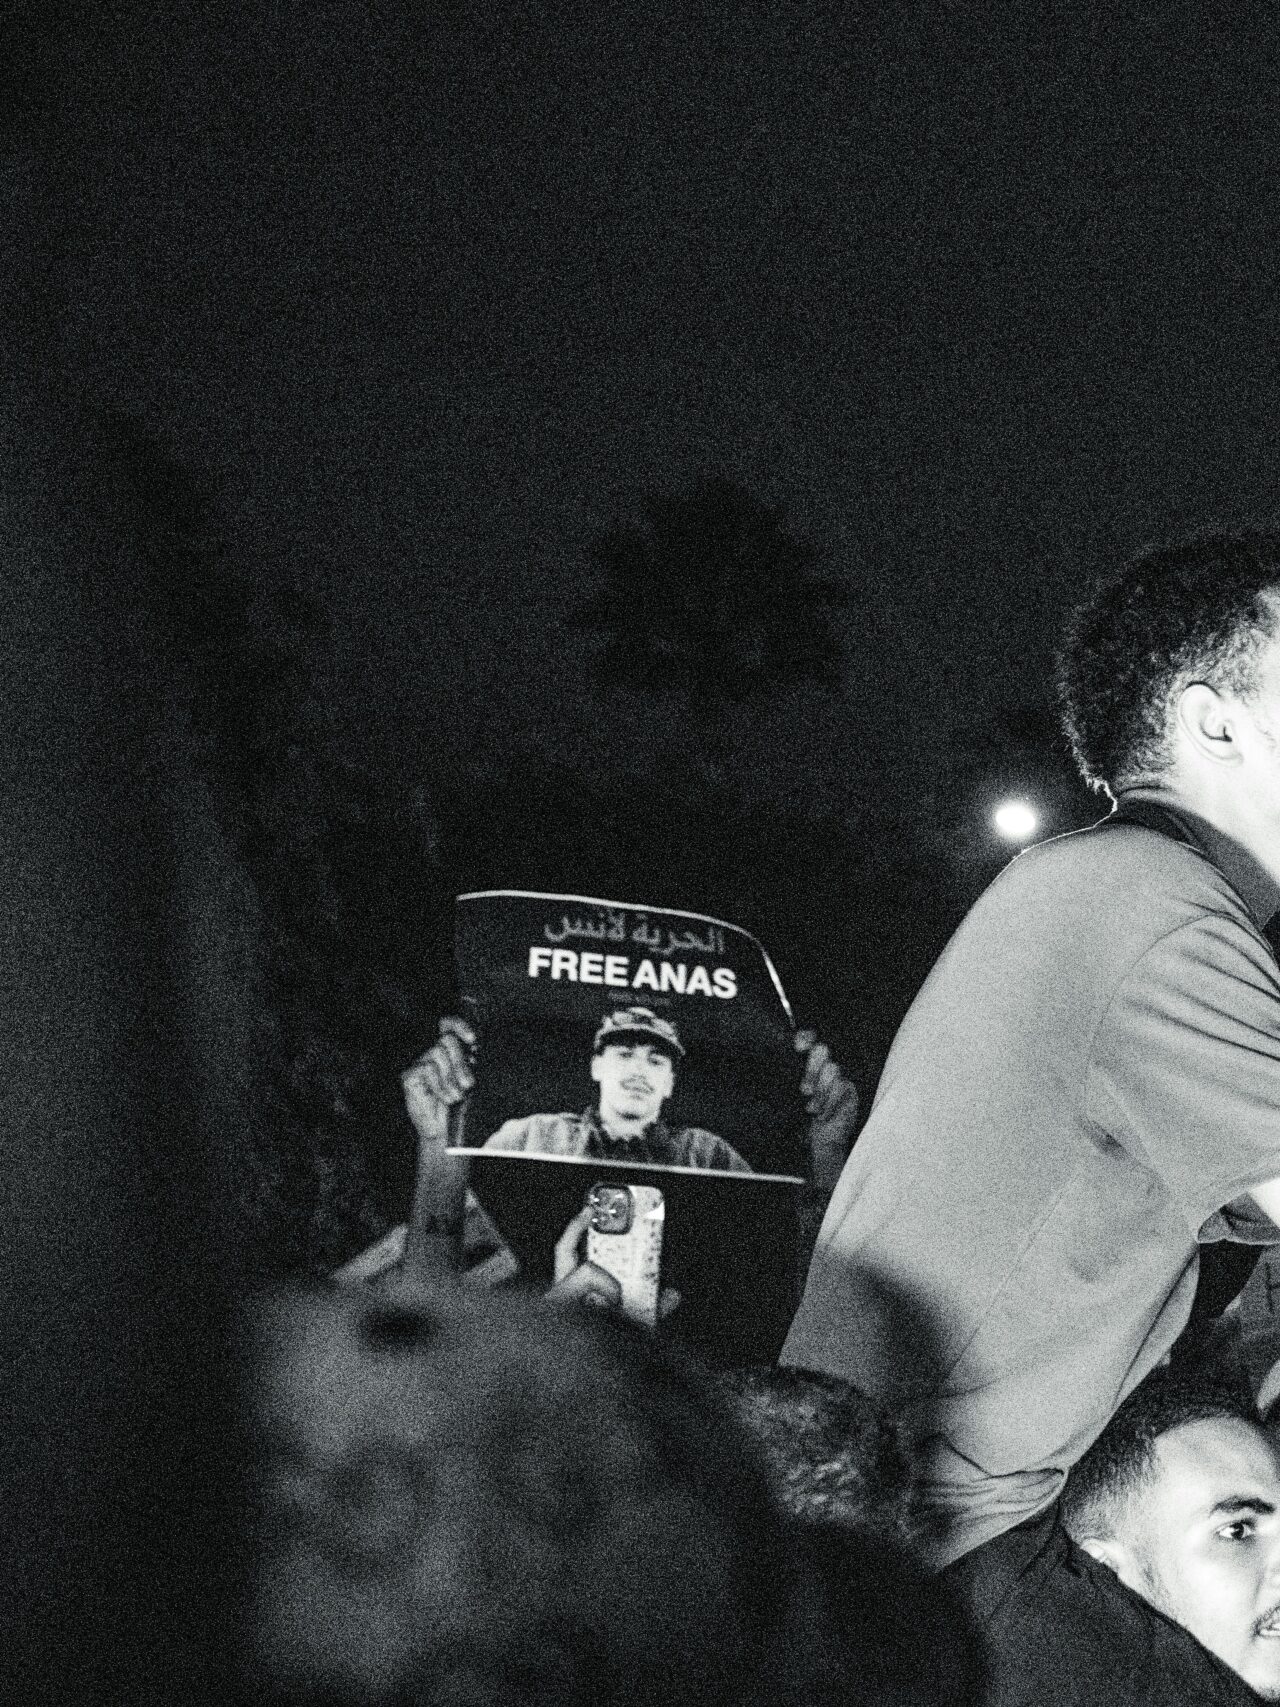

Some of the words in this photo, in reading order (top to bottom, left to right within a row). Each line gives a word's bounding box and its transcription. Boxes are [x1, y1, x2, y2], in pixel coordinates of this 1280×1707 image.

[632, 913, 725, 956] الحرية
[528, 947, 629, 988] FREE
[632, 960, 738, 999] ANAS
